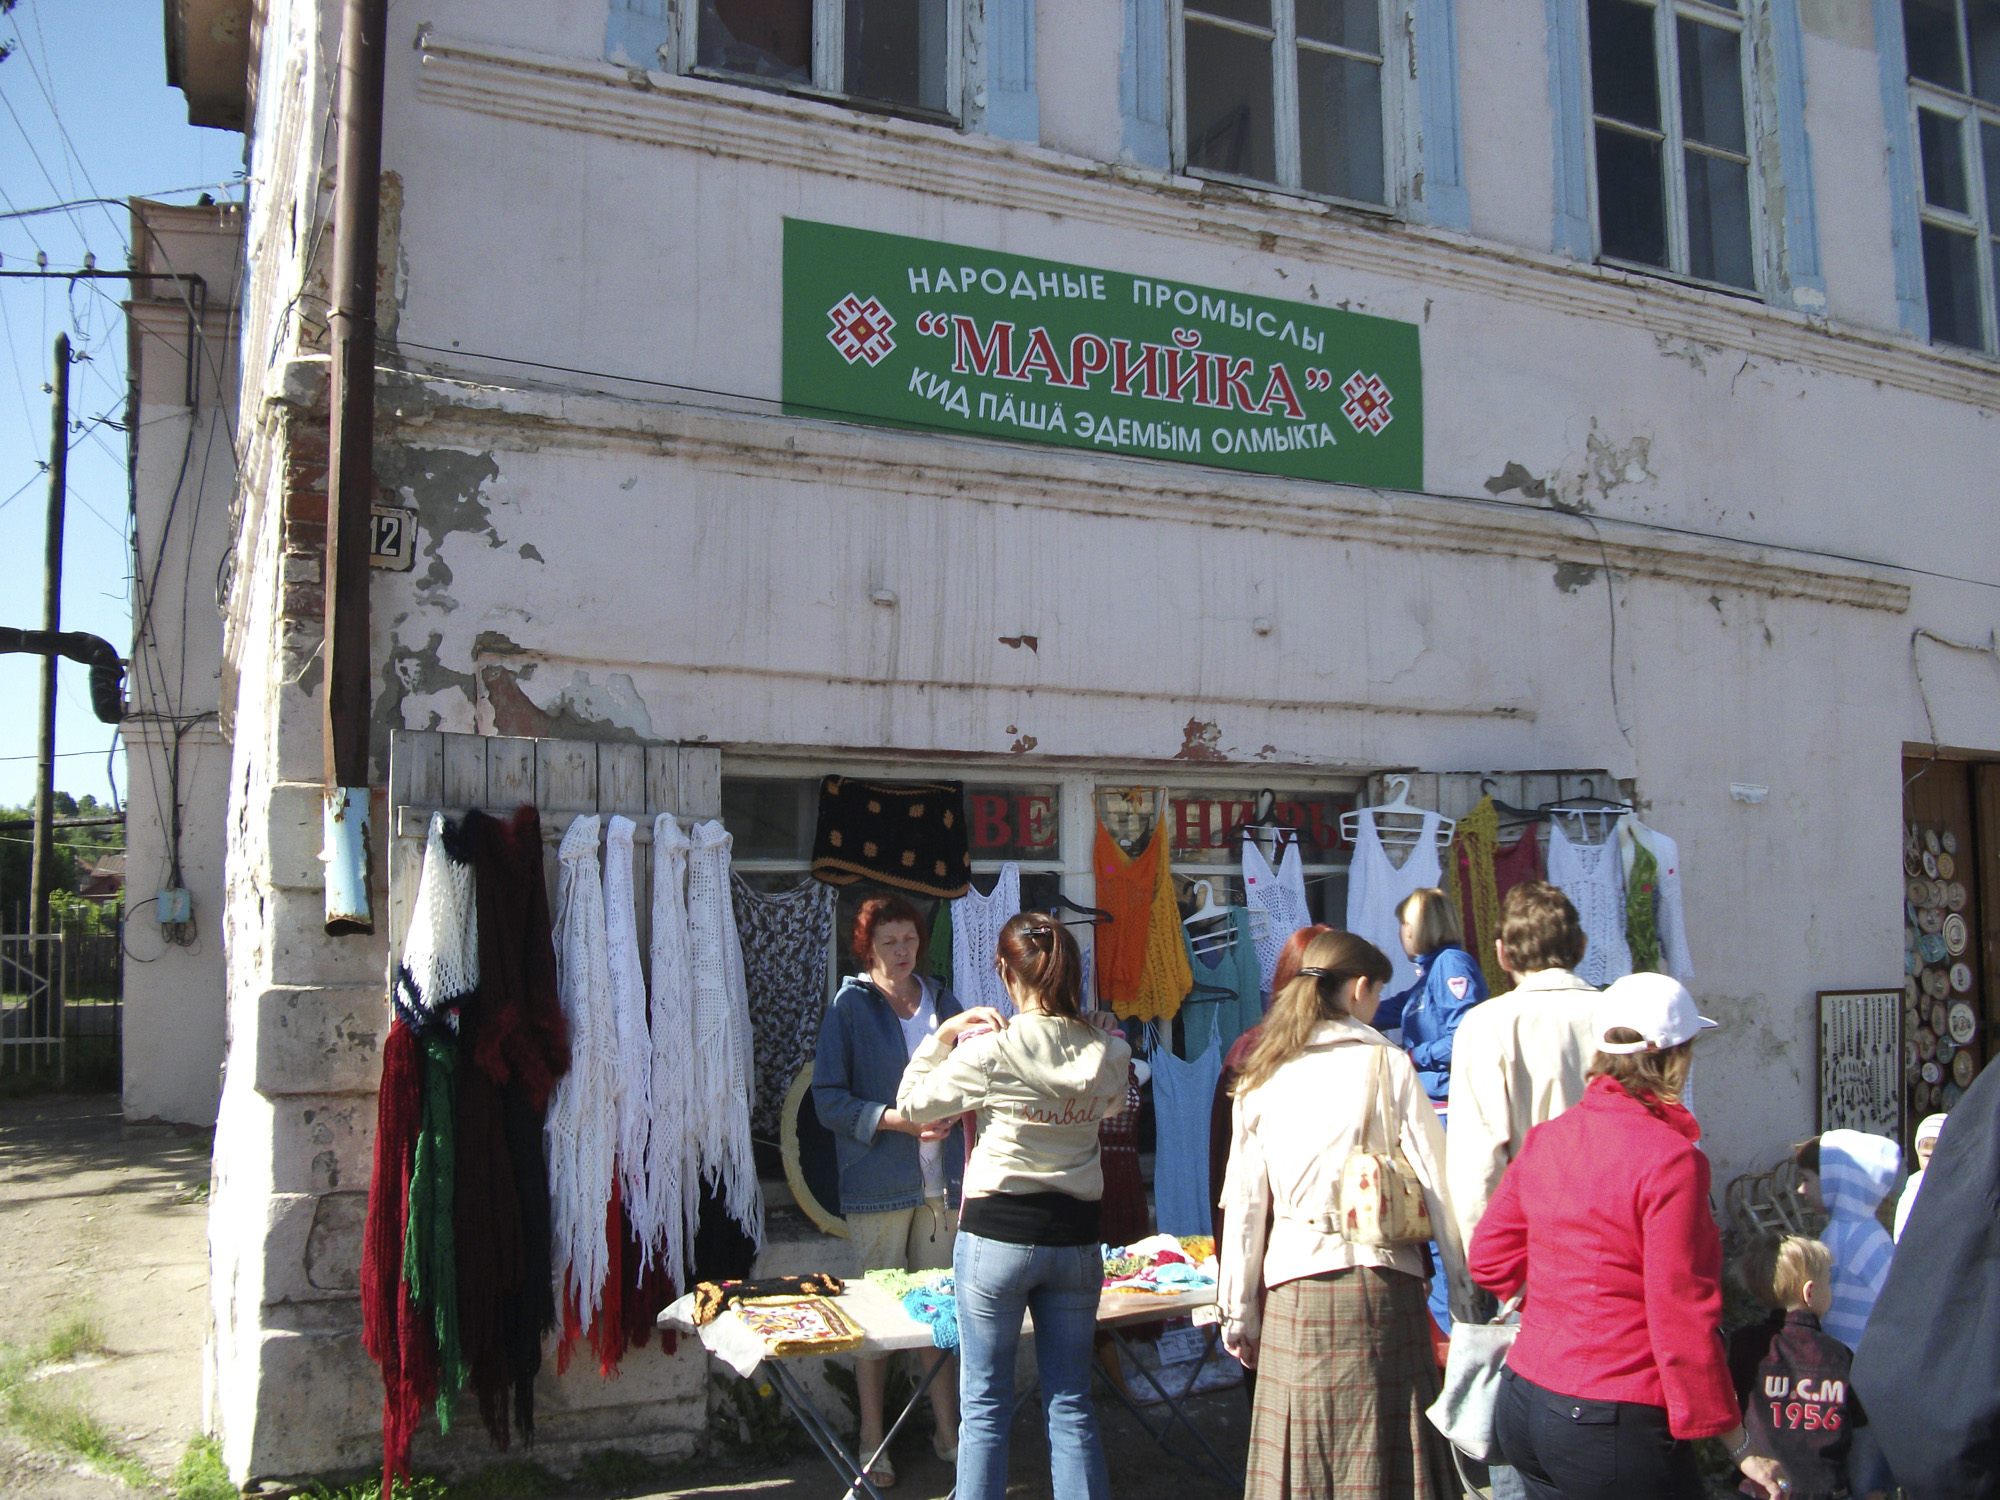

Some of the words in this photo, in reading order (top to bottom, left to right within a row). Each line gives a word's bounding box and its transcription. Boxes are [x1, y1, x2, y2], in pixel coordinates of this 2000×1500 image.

[907, 267, 1106, 302] НАРОДНЫЕ
[1133, 280, 1325, 354] ПРОМЫСЛЫ
[908, 366, 971, 419] КИД
[1211, 421, 1338, 454] ОЛМЫКТА
[1770, 1402, 1842, 1431] 1956
